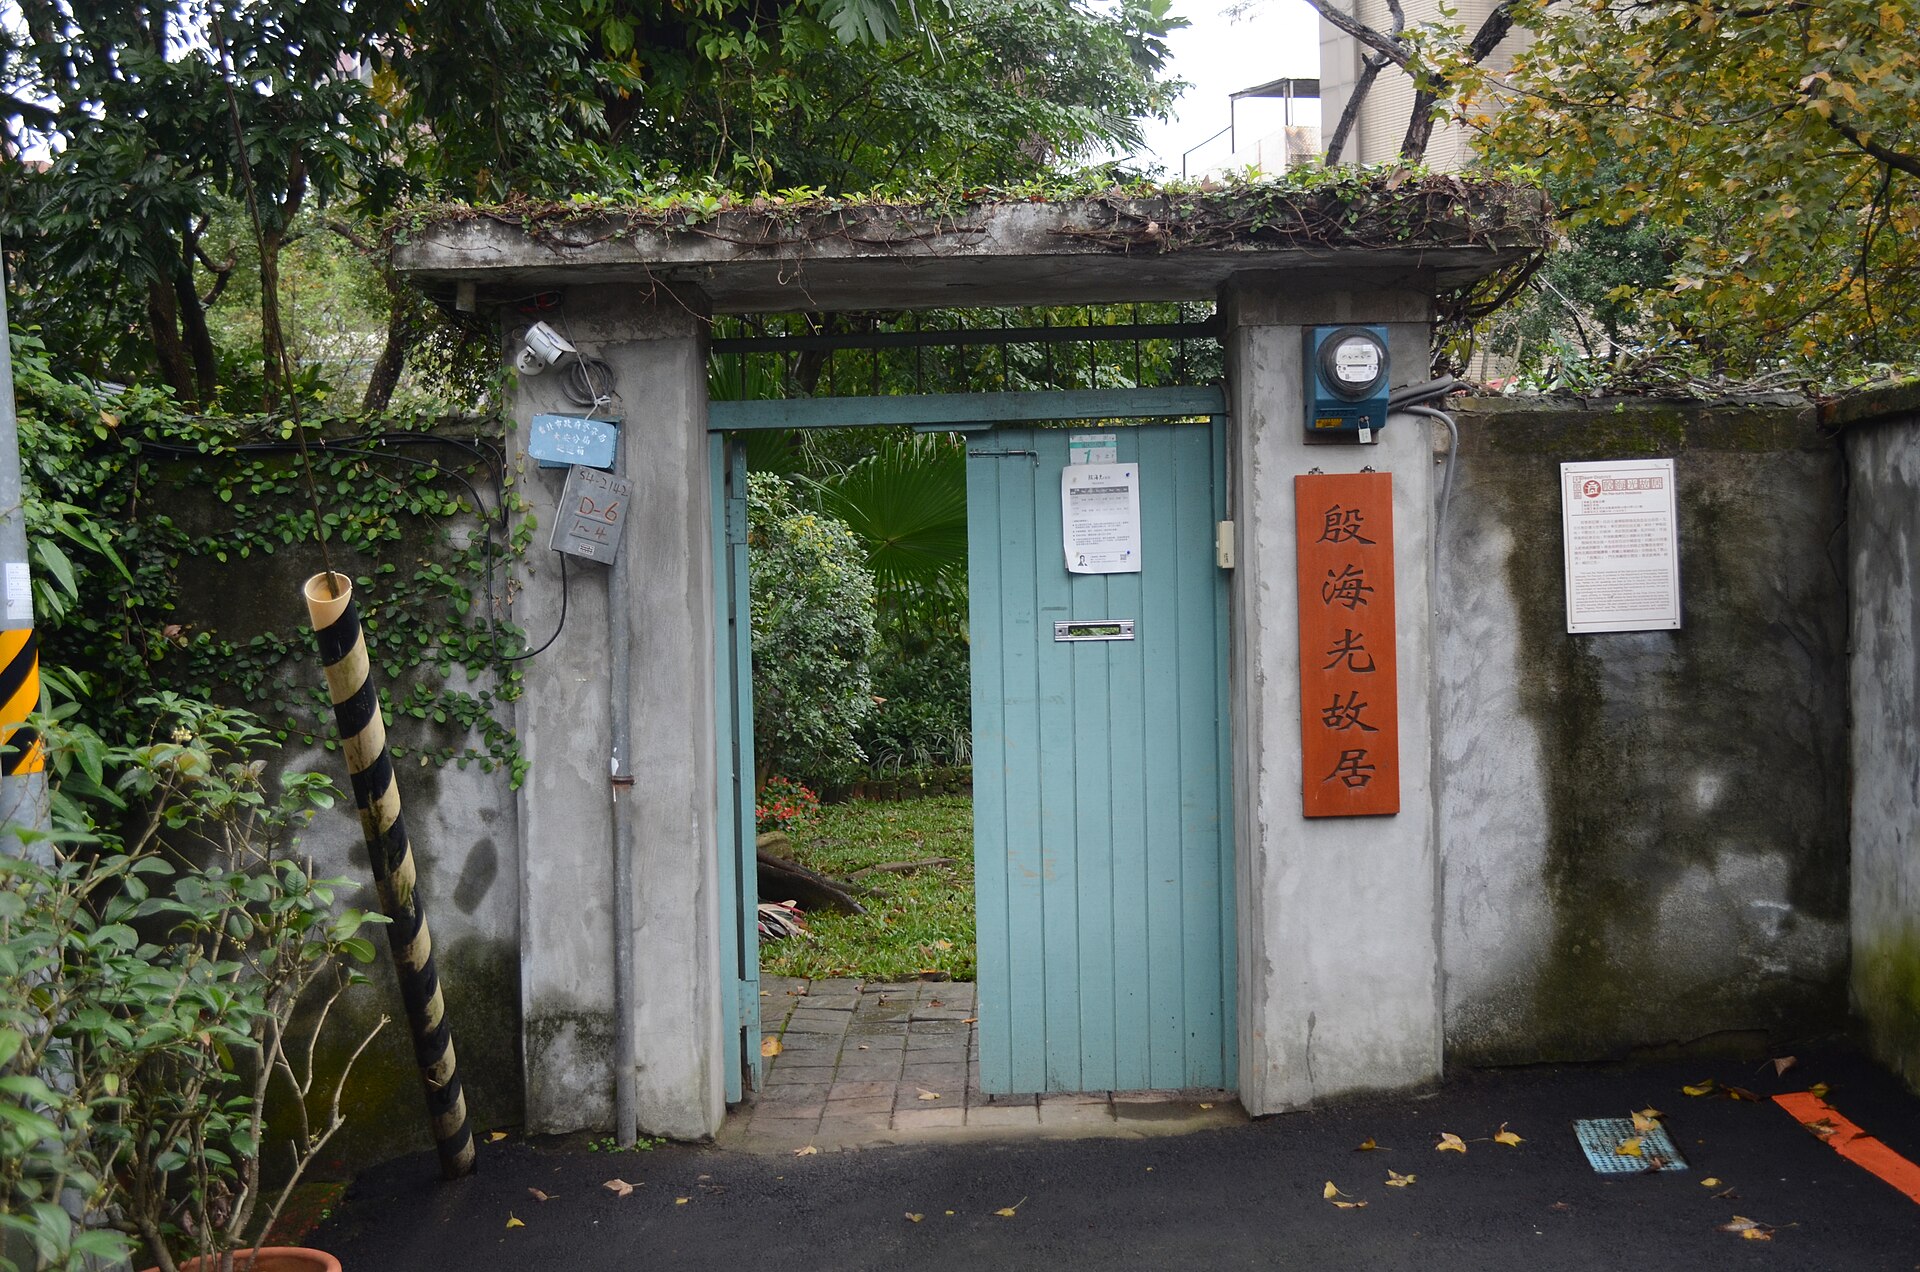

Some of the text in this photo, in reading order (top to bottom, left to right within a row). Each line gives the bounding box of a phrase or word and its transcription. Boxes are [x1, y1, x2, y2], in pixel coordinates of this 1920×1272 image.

[579, 496, 619, 522] D-6
[1316, 504, 1379, 789] 殷海光故居
